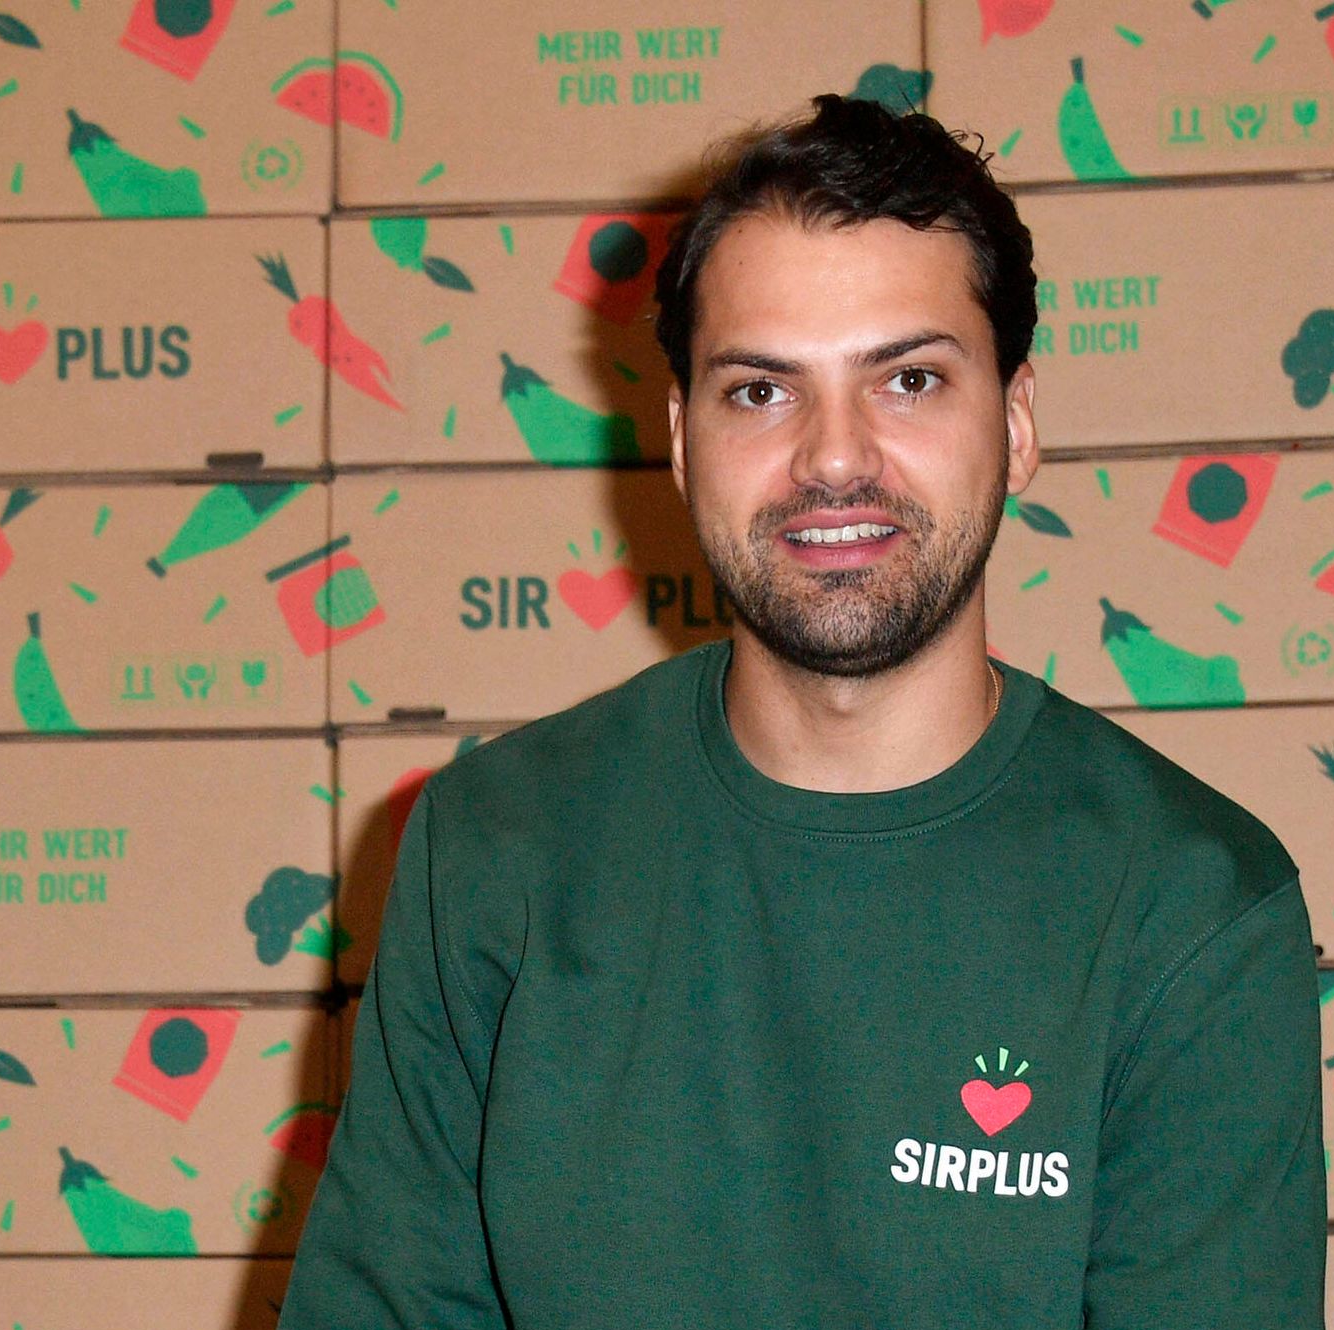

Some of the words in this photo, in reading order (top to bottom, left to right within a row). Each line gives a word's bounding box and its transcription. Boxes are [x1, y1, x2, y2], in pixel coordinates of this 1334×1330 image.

[537, 29, 622, 64] MEHR
[636, 27, 723, 60] WERT
[558, 65, 618, 106] FÜR
[632, 72, 701, 105] DICH
[1072, 275, 1161, 310] WERT
[55, 323, 192, 382] PLUS
[1069, 321, 1140, 356] DICH
[460, 575, 552, 631] SIR
[646, 574, 734, 628] PLU
[42, 827, 129, 861] WERT
[37, 872, 108, 905] DICH
[890, 1137, 1070, 1197] SIRPLUS
